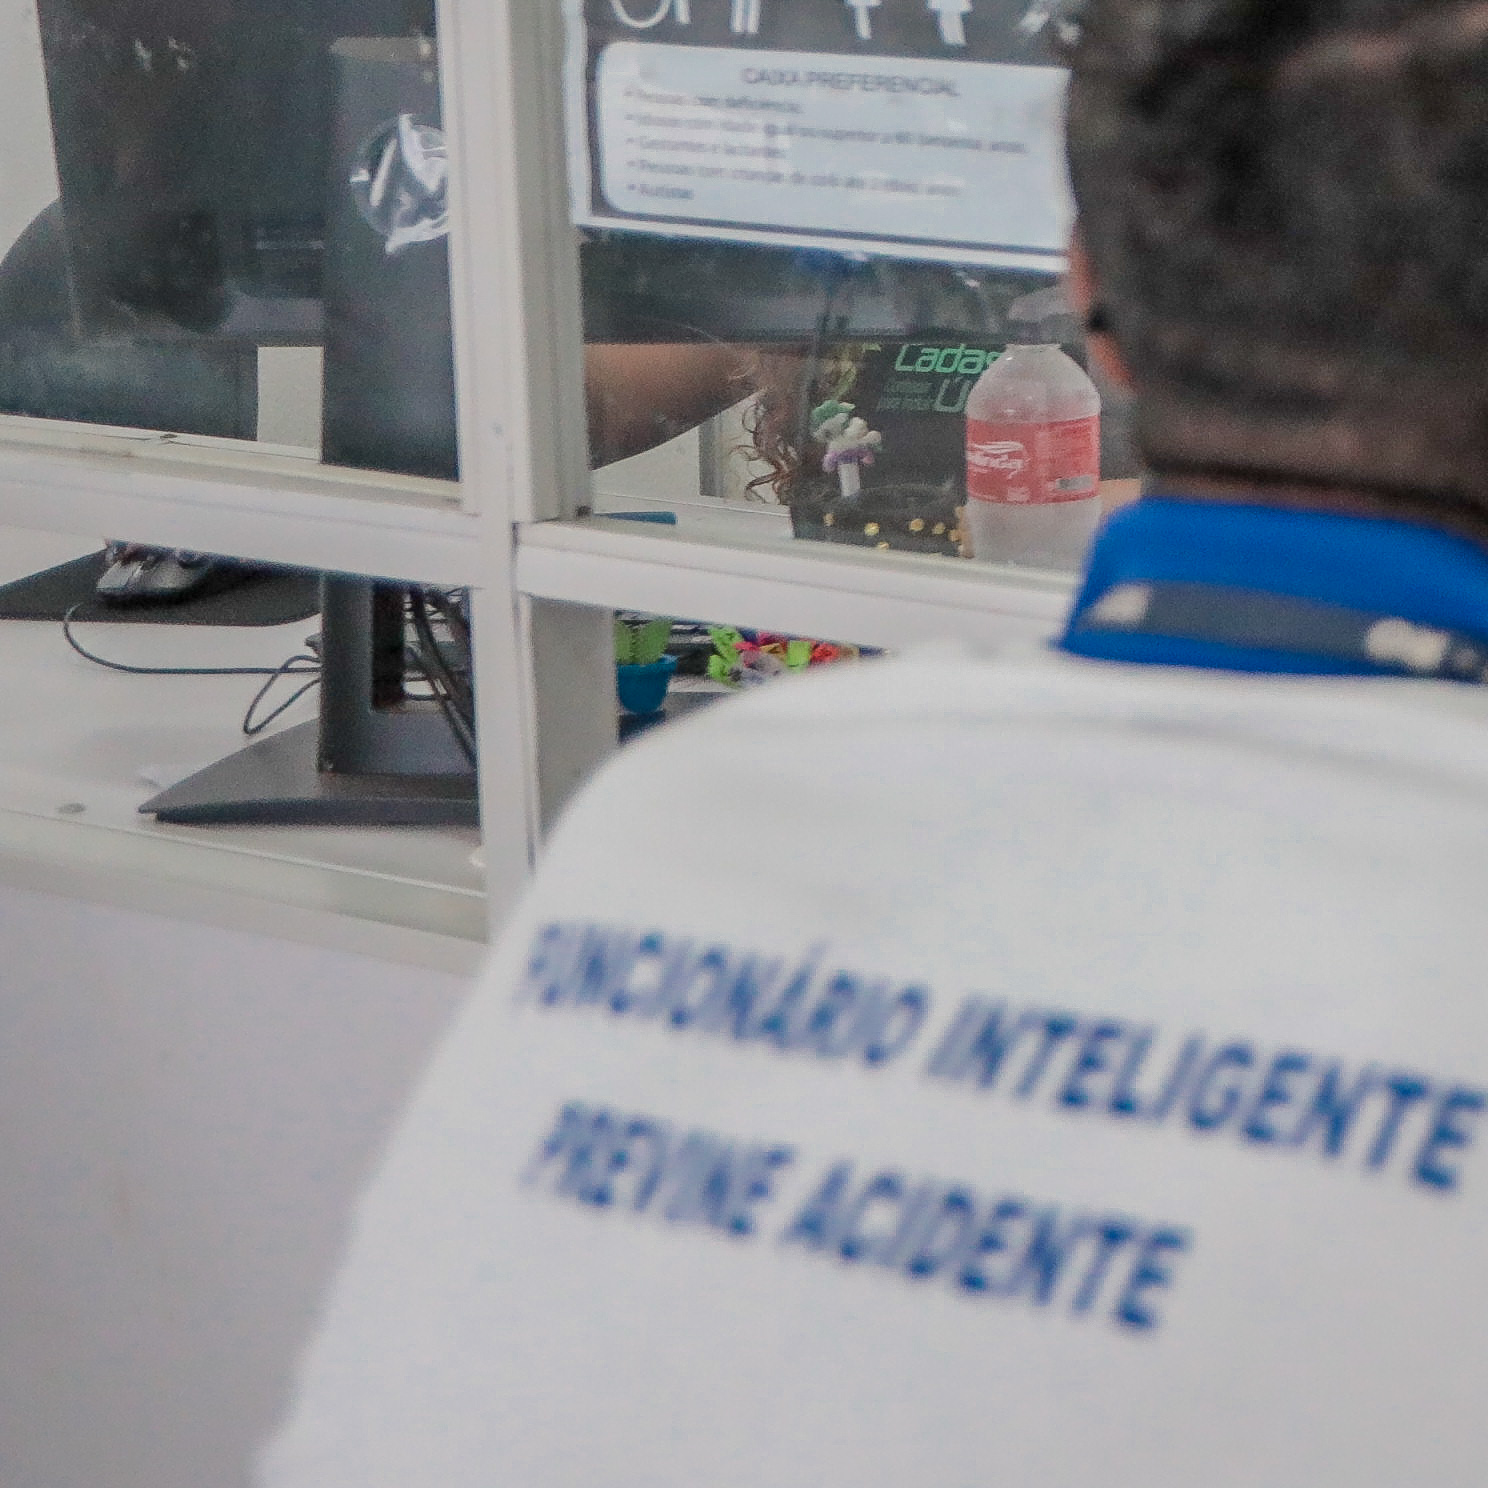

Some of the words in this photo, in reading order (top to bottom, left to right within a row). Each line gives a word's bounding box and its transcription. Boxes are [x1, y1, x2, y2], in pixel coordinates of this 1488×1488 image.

[518, 920, 932, 1069] FUNCIONÁRIO
[522, 1100, 794, 1243] PREVINE
[784, 1157, 1195, 1335] ACIDENTE
